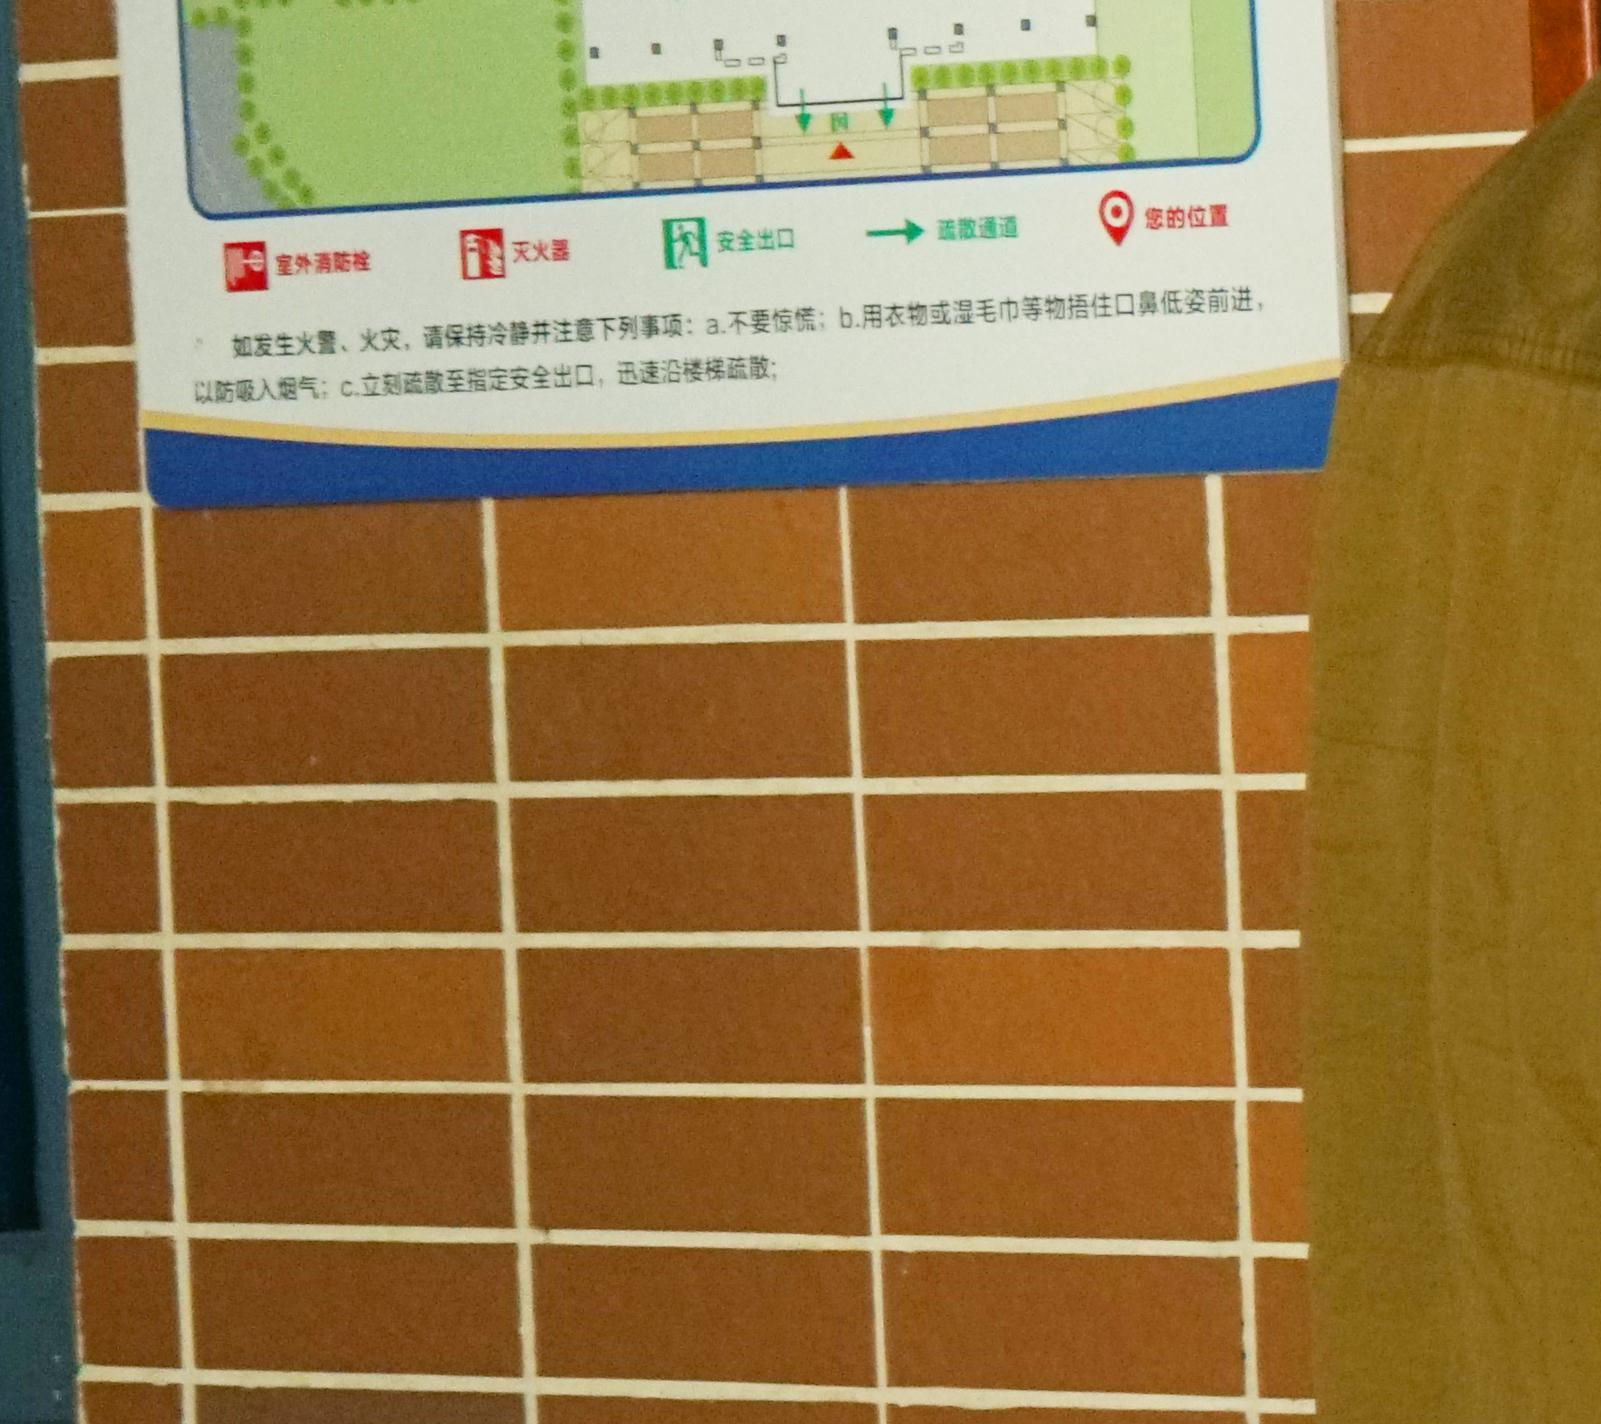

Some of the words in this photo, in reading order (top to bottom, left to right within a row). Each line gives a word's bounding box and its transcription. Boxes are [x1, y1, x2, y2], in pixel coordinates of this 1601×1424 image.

[936, 214, 1020, 243] 疏散通道
[1143, 202, 1230, 232] 您的位置
[511, 237, 571, 266] 灭火器
[716, 227, 796, 254] 安全出口
[274, 249, 372, 278] 室外消防栓
